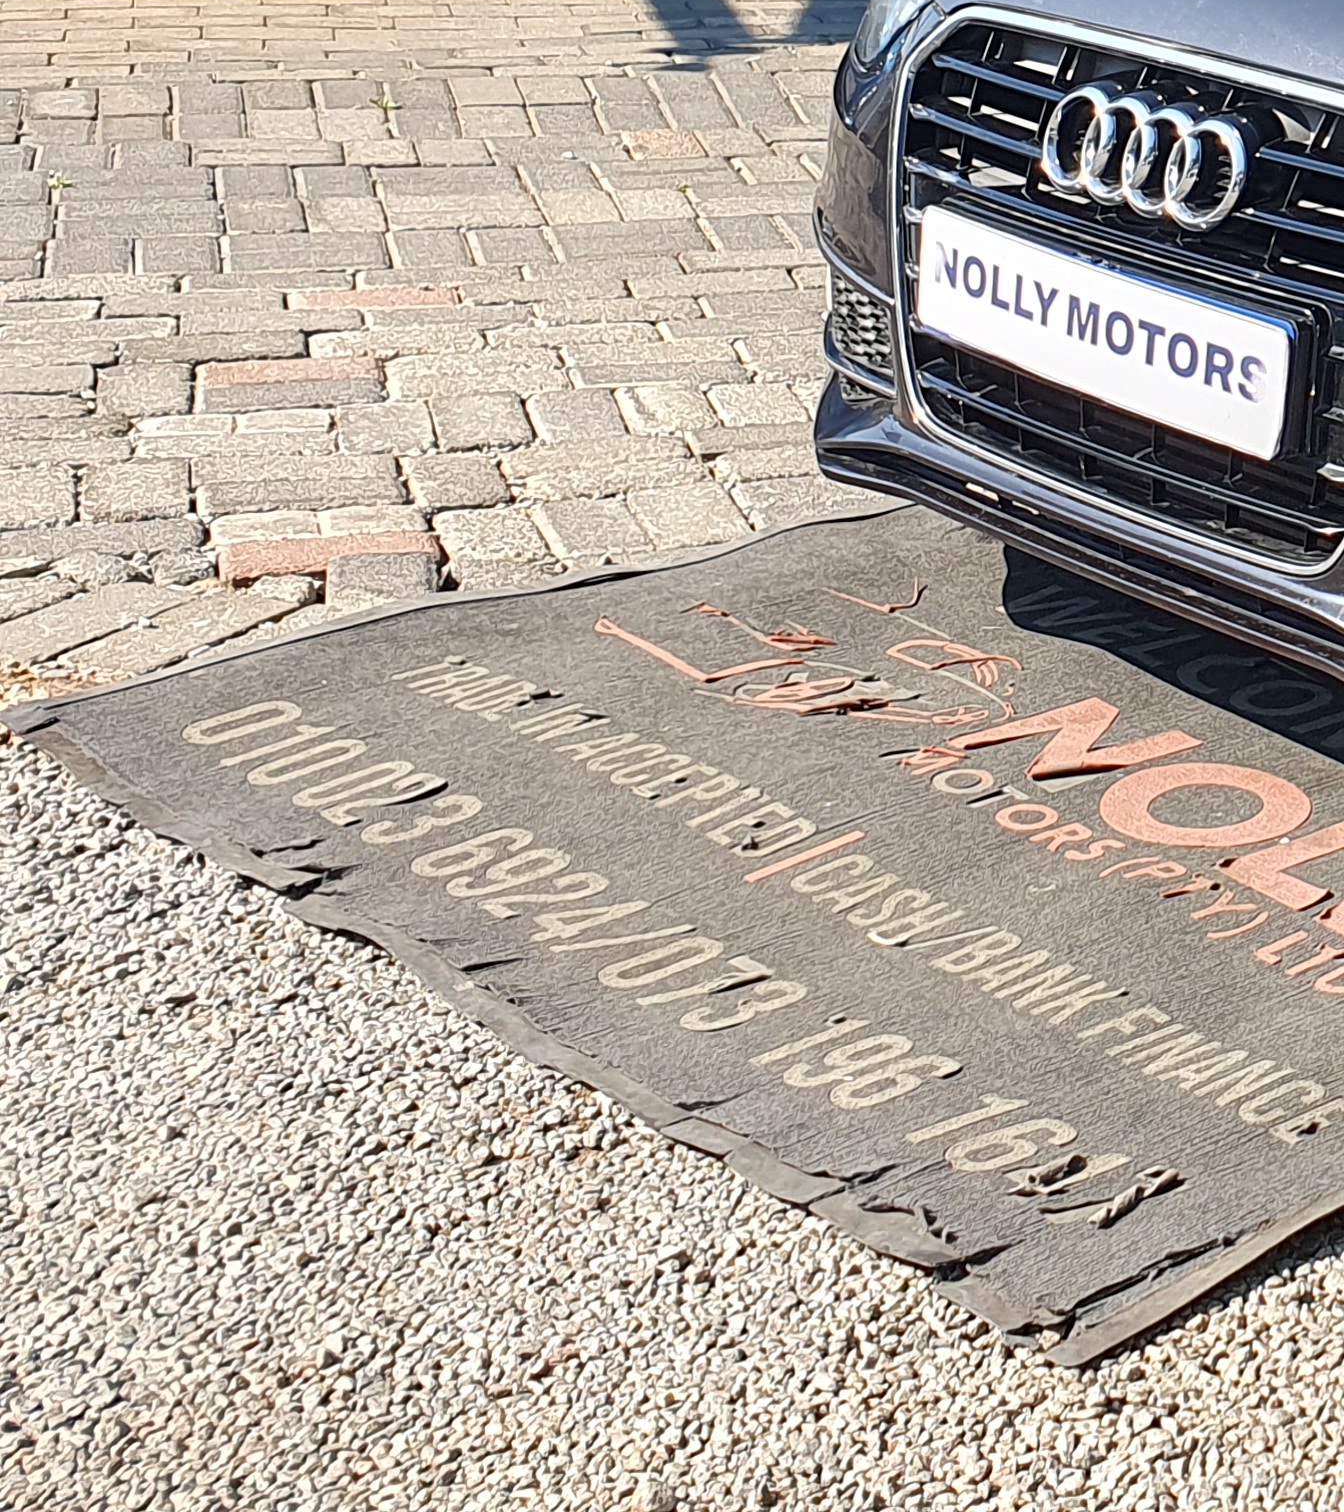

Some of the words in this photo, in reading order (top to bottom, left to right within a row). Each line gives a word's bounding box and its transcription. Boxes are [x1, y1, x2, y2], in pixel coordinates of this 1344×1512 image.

[934, 240, 1059, 328] NOLLY
[1066, 293, 1267, 403] MOTORS
[879, 745, 1126, 861] MOTORS
[748, 1012, 963, 1110] 196
